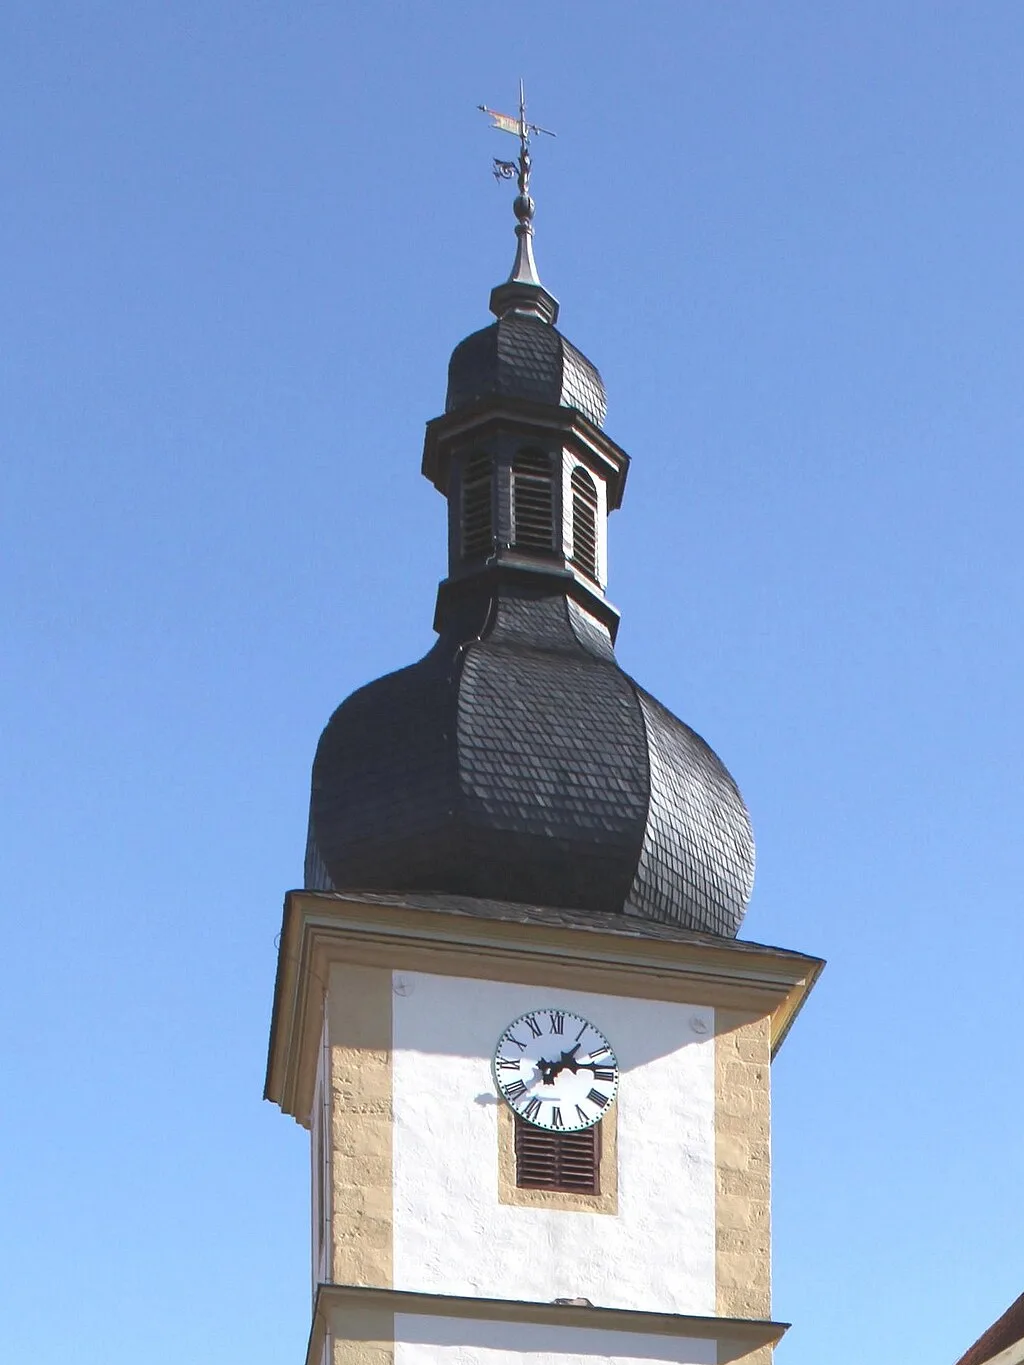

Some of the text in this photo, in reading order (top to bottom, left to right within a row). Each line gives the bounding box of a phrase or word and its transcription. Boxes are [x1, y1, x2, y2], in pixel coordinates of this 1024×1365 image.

[526, 1016, 542, 1039] XI
[550, 1014, 564, 1035] XII
[575, 1022, 588, 1042] I
[506, 1034, 527, 1052] X
[589, 1047, 608, 1058] II
[500, 1057, 520, 1070] IX
[504, 1079, 528, 1100] VIII
[524, 1098, 542, 1120] VII
[552, 1106, 564, 1126] VI
[575, 1104, 589, 1122] V
